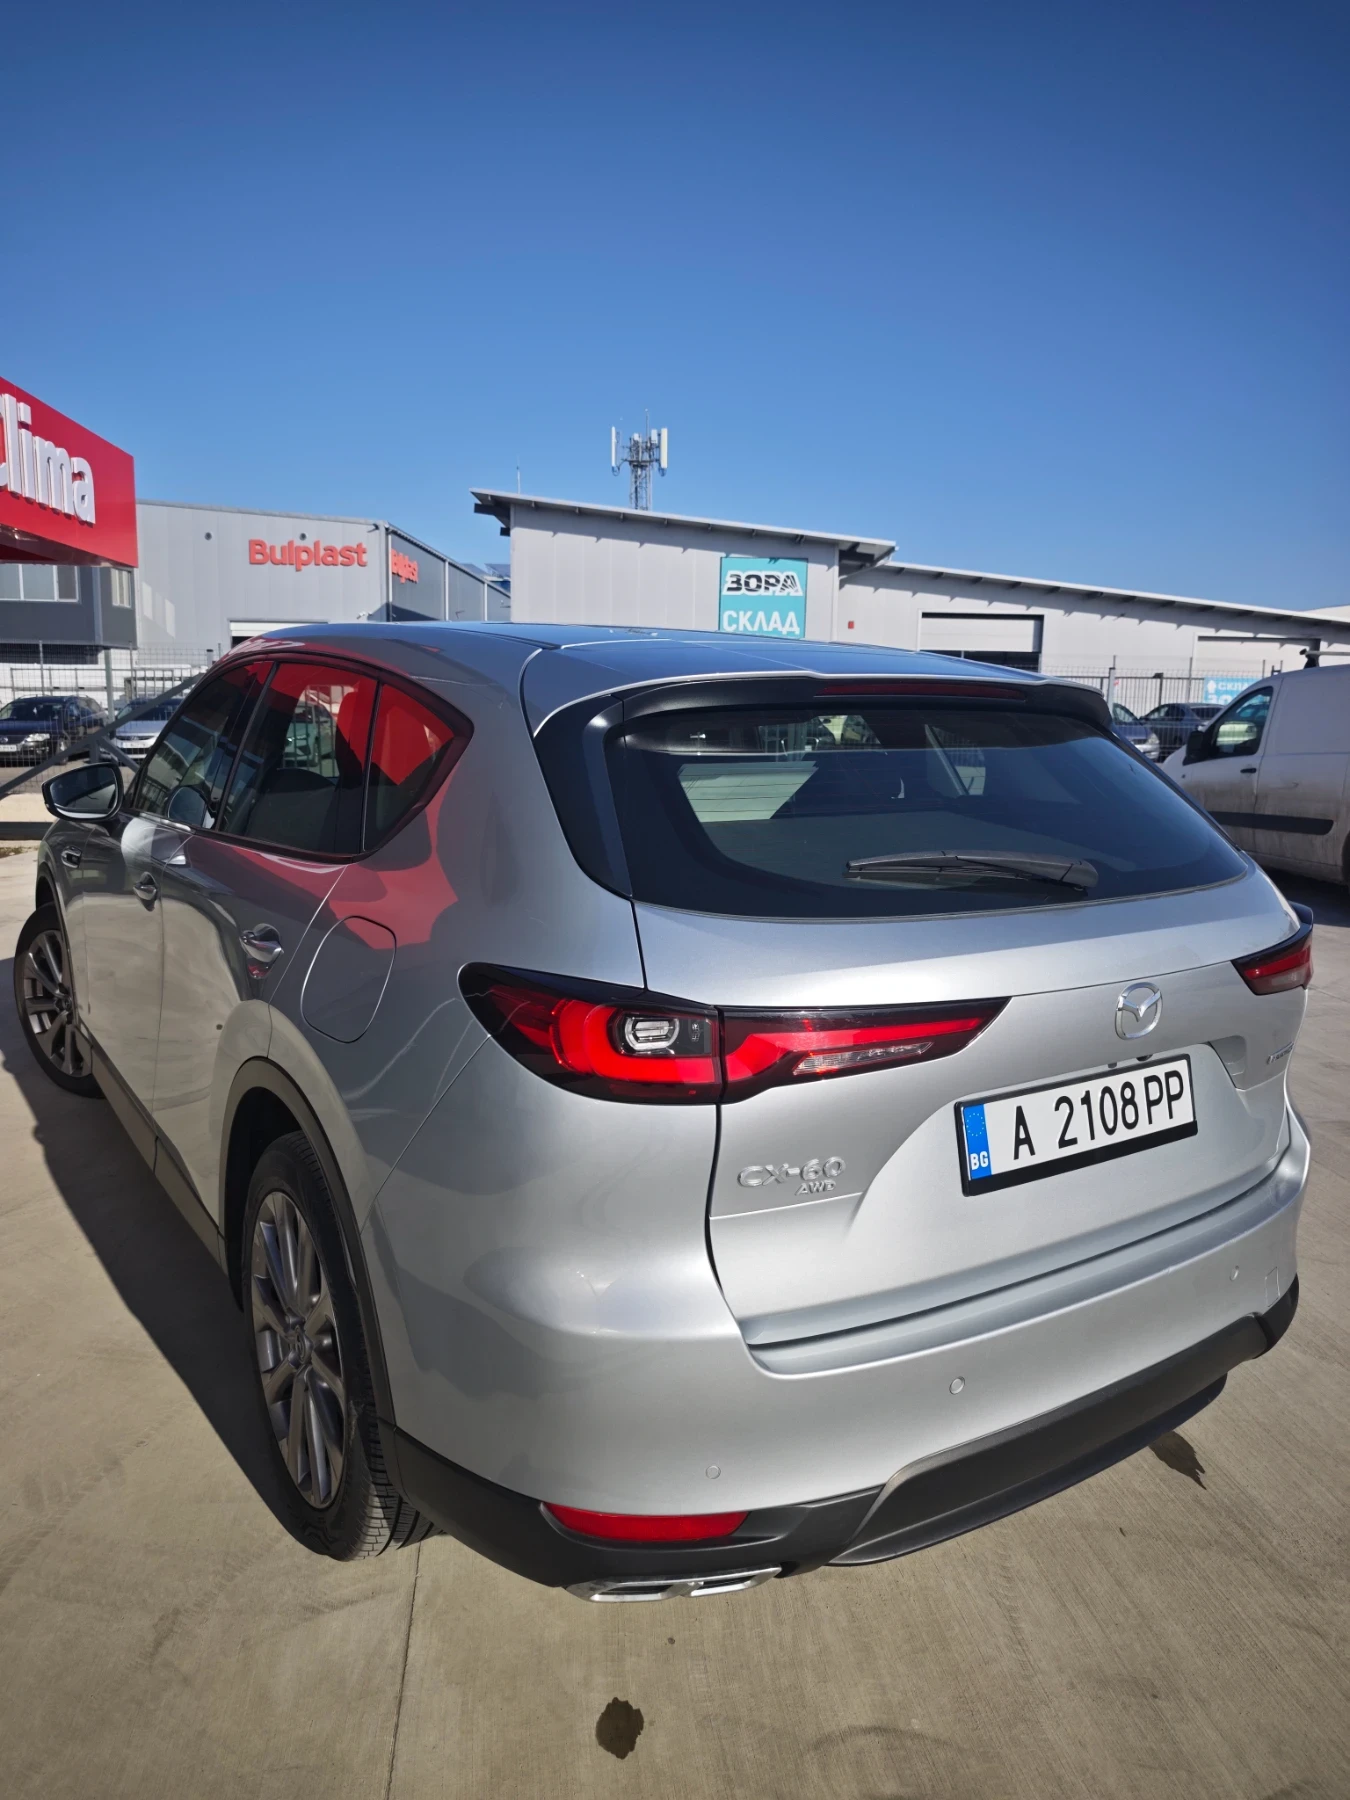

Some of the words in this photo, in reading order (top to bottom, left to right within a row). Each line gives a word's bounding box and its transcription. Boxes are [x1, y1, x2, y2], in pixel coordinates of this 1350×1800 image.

[249, 539, 368, 572] Bulplast
[724, 571, 802, 595] ЗОРА
[722, 610, 800, 635] СКЛАД
[1218, 682, 1249, 691] СКЛА
[1013, 1105, 1036, 1160] A
[738, 1156, 846, 1187] CX-60
[970, 1151, 989, 1170] BG
[796, 1179, 836, 1195] AWD
